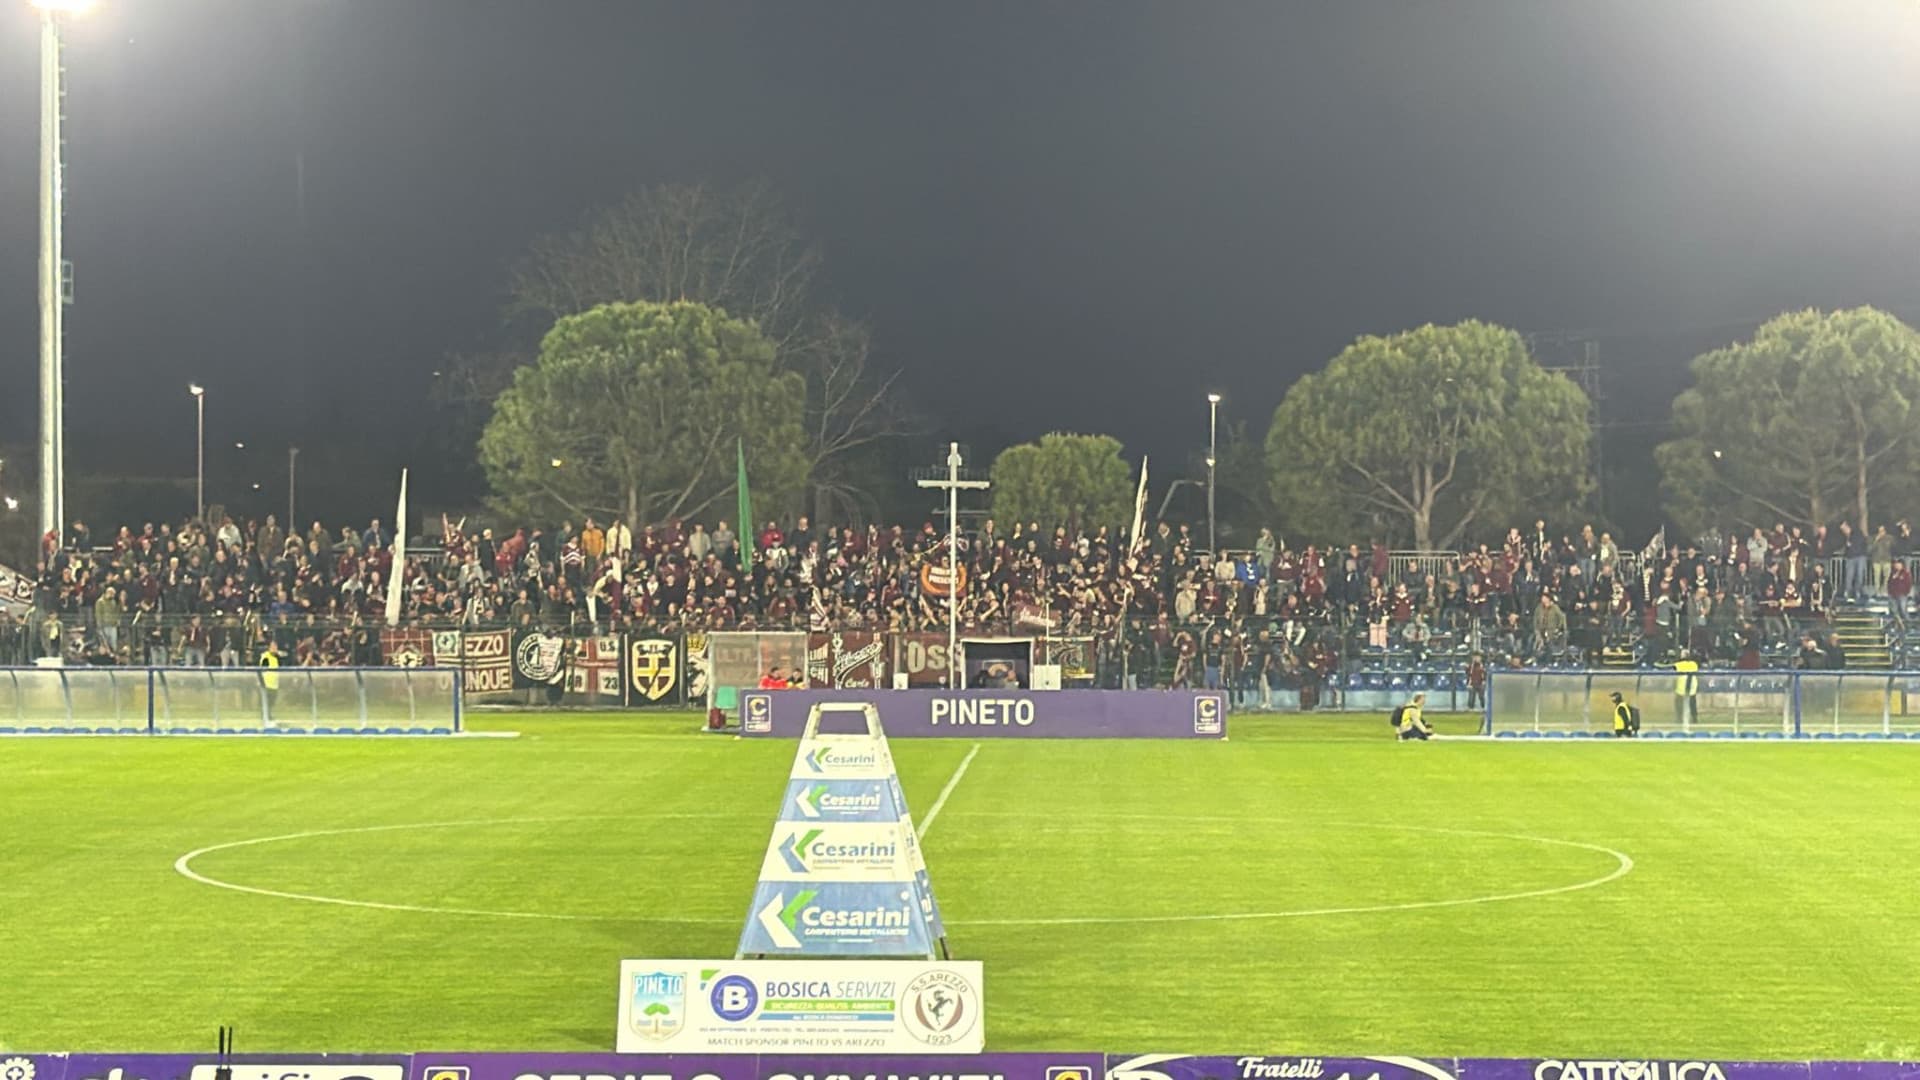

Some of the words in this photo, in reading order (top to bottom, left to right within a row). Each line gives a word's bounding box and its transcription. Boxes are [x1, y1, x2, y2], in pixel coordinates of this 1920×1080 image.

[931, 698, 1035, 726] PINETO
[825, 750, 875, 764] Cesarini
[820, 789, 880, 806] Cesarini
[812, 836, 895, 857] Cesarini
[802, 899, 910, 927] Cesarini
[635, 975, 682, 995] PINETO
[766, 981, 831, 998] BOSICA
[836, 981, 896, 998] SERVIZI
[722, 985, 749, 1011] B
[793, 1038, 828, 1046] PINETO
[831, 1038, 842, 1046] VS
[845, 1038, 885, 1046] AREZZO
[1237, 1056, 1324, 1079] Fratelli
